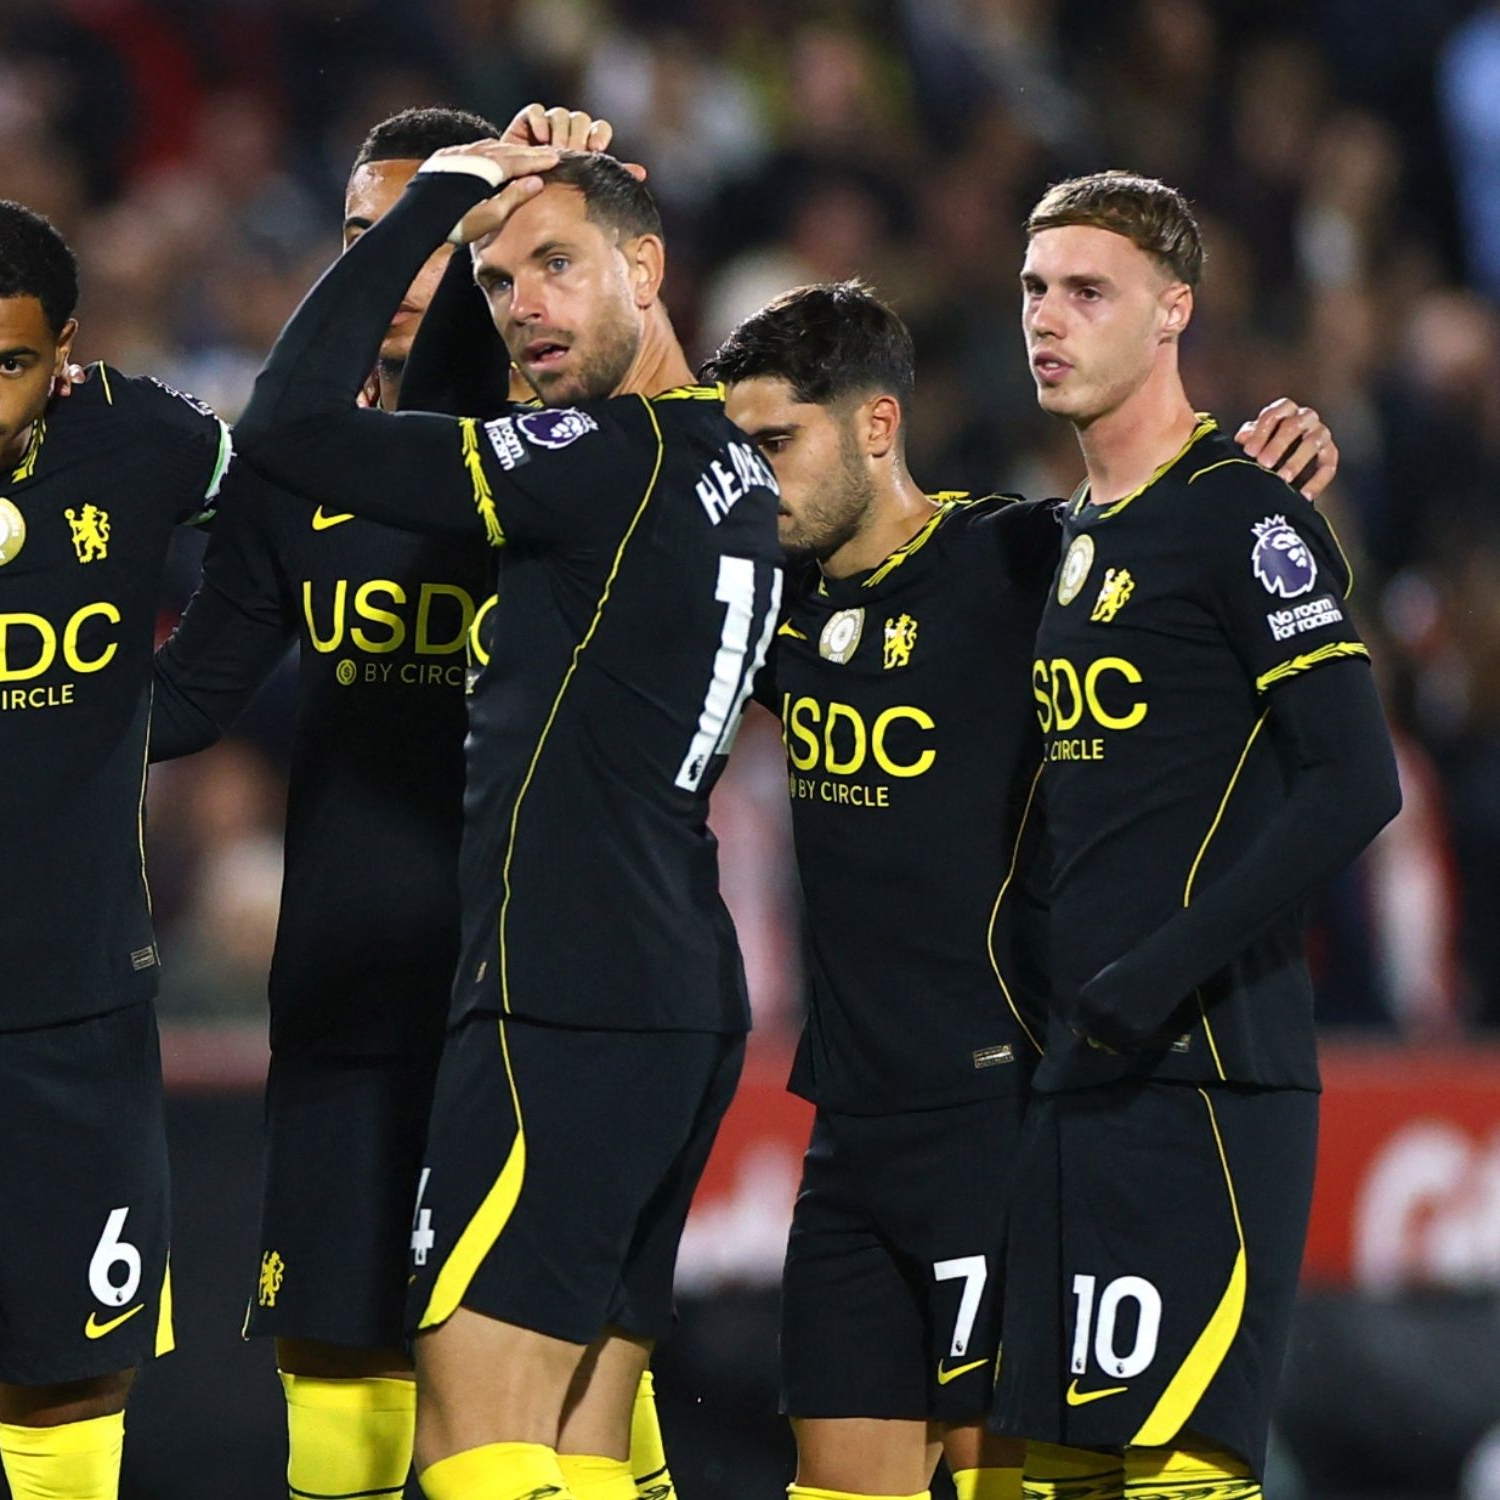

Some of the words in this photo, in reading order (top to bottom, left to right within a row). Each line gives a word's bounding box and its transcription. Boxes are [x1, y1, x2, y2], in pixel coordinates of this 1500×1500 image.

[1267, 610, 1293, 626] No
[1293, 598, 1333, 620] room
[1273, 621, 1297, 641] for
[1297, 609, 1343, 633] racism
[365, 663, 393, 682] BY
[1050, 739, 1104, 761] CIRCLE
[799, 778, 815, 799] BY
[820, 782, 890, 807] CIRCLE
[88, 1206, 142, 1307] 6
[933, 1255, 988, 1357] 7
[1070, 1273, 1163, 1379] 10
